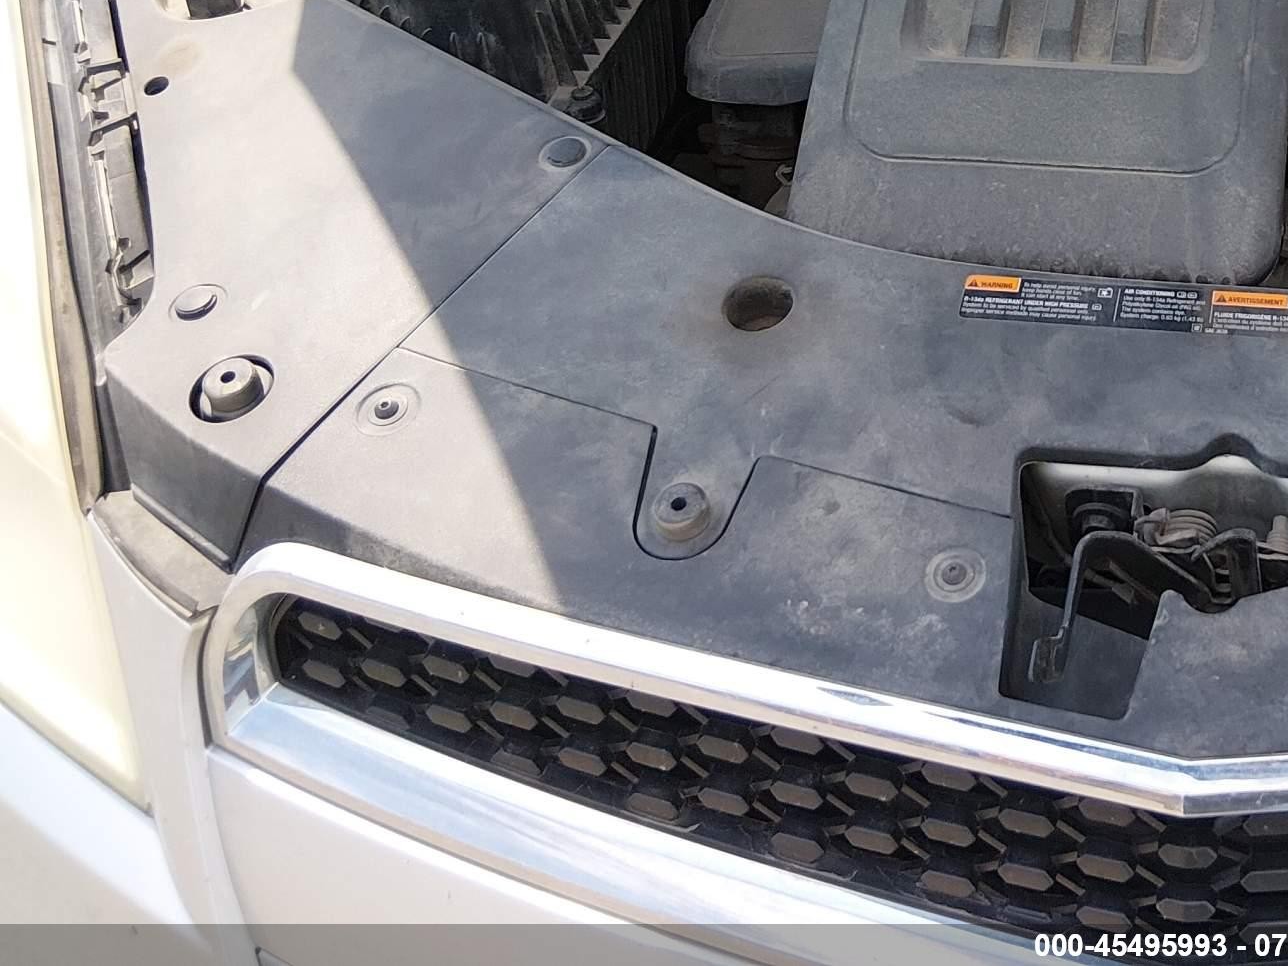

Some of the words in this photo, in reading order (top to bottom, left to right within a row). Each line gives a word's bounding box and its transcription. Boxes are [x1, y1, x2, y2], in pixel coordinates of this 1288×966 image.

[981, 281, 1013, 289] WARNING
[1135, 289, 1175, 297] CONDITIONING
[1228, 296, 1283, 306] AVERTISSEMENT
